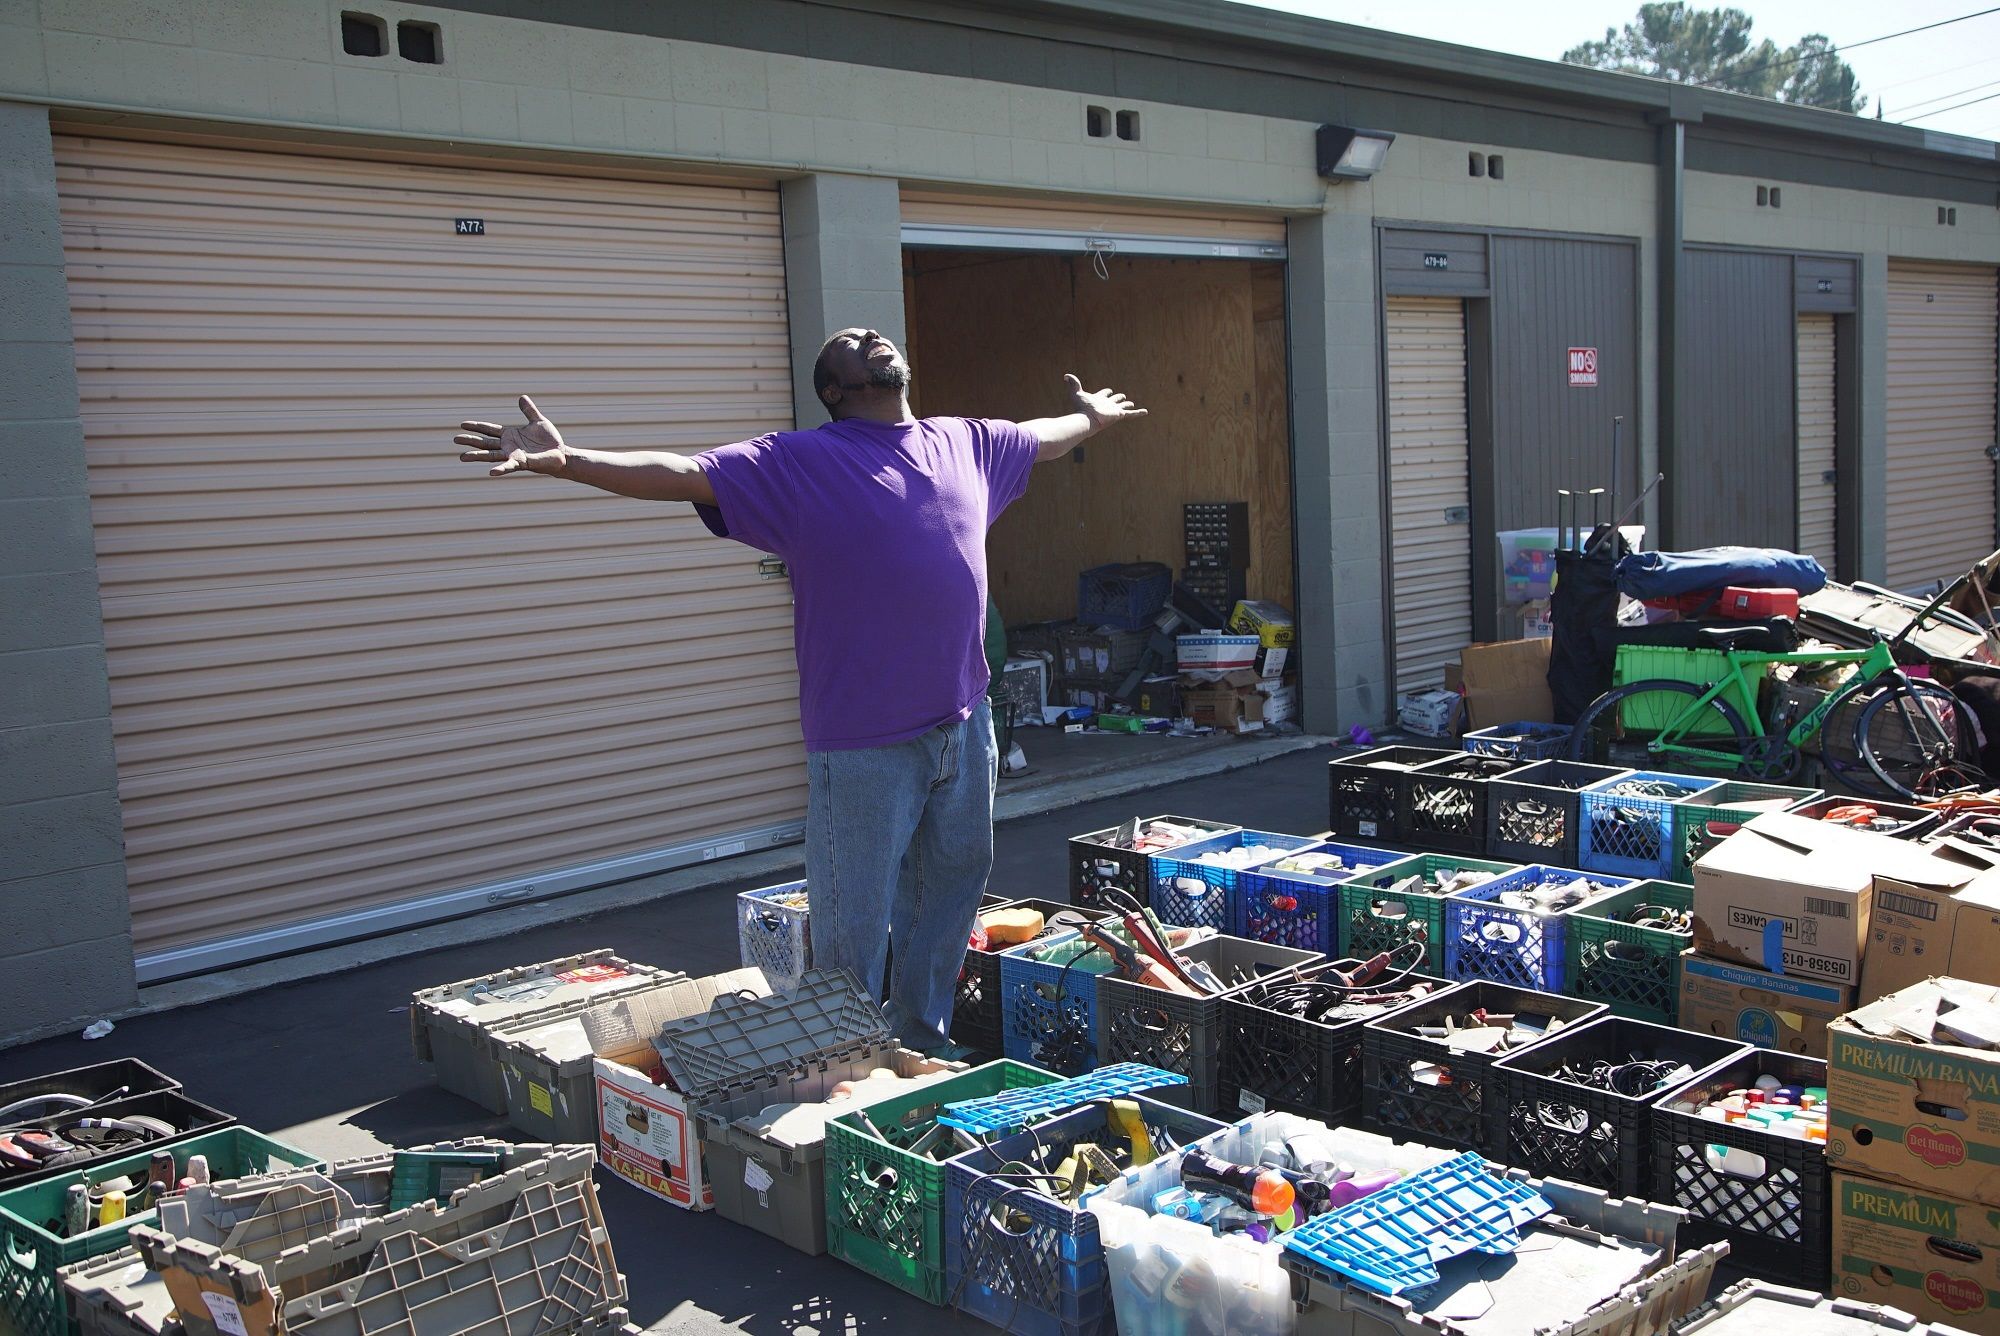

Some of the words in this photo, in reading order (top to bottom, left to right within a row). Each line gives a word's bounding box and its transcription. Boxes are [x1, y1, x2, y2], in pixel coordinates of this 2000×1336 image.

[460, 221, 480, 232] A77
[1571, 351, 1584, 371] NO
[1570, 372, 1596, 383] SMOKING
[1733, 911, 1767, 928] CAKES
[1721, 969, 1757, 984] Chiquita
[1761, 977, 1799, 992] Bananas
[1740, 1029, 1773, 1043] Chiquita
[1841, 1044, 1934, 1079] PREMIUM
[1909, 1134, 1927, 1147] Del
[1928, 1139, 1962, 1157] Monte
[610, 1153, 673, 1197] KARLA
[1852, 1191, 1950, 1230] PREMIUM
[1929, 1279, 1946, 1292] Del
[1948, 1284, 1983, 1303] Monte
